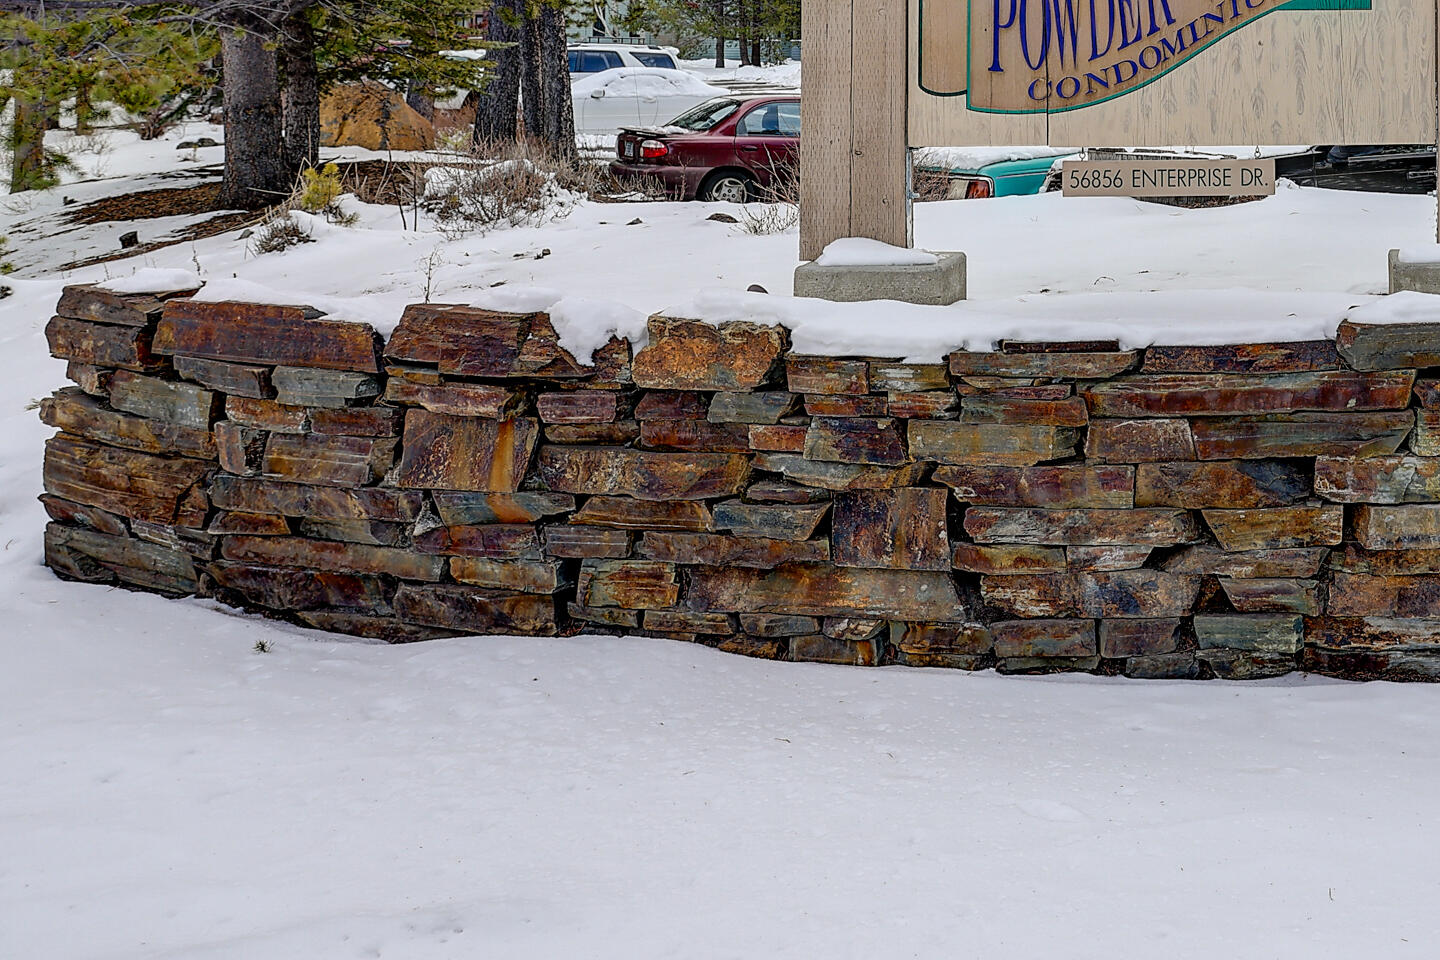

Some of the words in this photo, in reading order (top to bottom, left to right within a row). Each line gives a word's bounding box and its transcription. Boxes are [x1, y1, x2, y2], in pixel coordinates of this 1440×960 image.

[1069, 169, 1124, 189] 56856
[1131, 167, 1232, 188] ENTERPRISE
[1240, 167, 1269, 187] DR.
